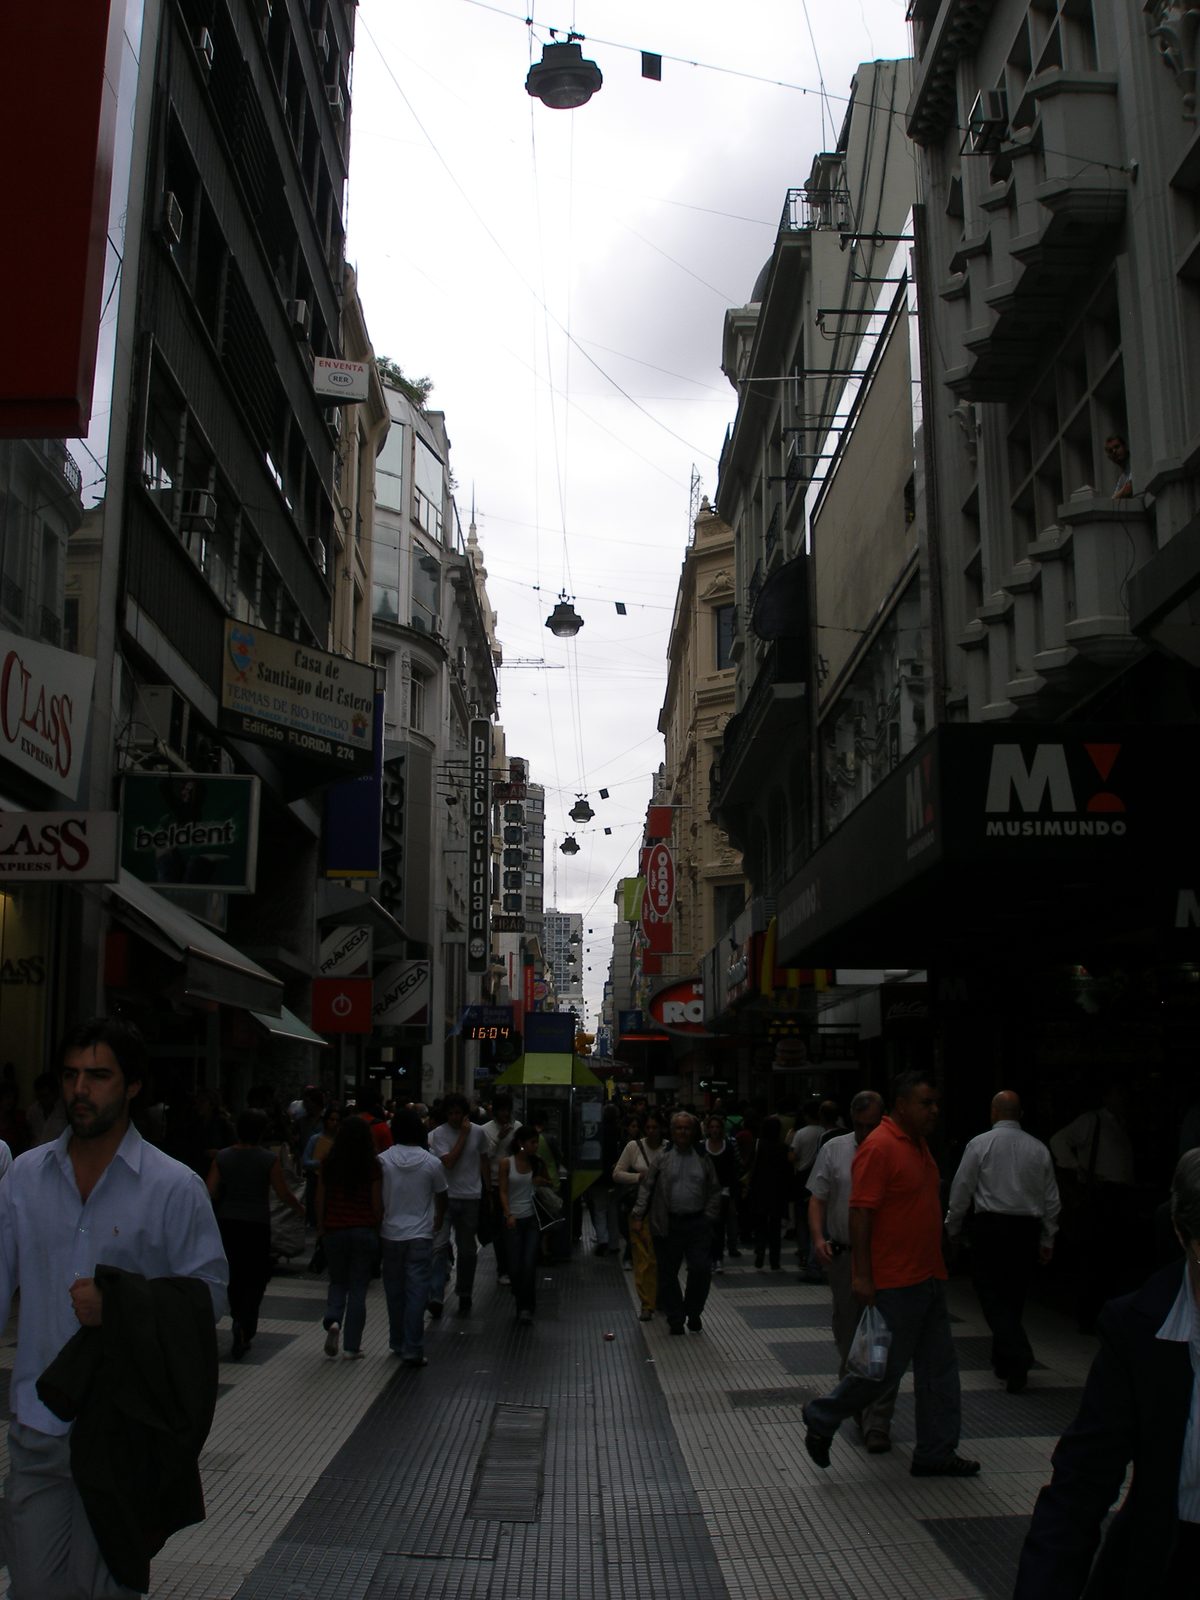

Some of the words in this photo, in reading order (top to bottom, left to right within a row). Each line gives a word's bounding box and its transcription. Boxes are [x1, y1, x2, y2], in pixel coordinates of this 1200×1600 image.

[319, 360, 331, 369] EN
[332, 361, 364, 373] VENTA
[257, 661, 312, 696] Santiago
[315, 680, 334, 702] del
[337, 687, 372, 714] Estero
[295, 650, 322, 675] Casa
[325, 659, 339, 680] de
[1, 650, 73, 778] CLASS
[227, 683, 271, 708] TERMAS
[273, 699, 288, 713] DE
[312, 710, 349, 733] HONDO
[21, 736, 54, 771] EXPRESS
[242, 716, 284, 741] Edificio
[288, 731, 332, 755] FLORIDA
[336, 745, 355, 760] 274
[473, 736, 486, 817] banco
[136, 820, 235, 850] beldent
[985, 820, 1128, 837] MUSIMUNDO
[472, 829, 486, 931] ciudad
[657, 851, 669, 907] RODO
